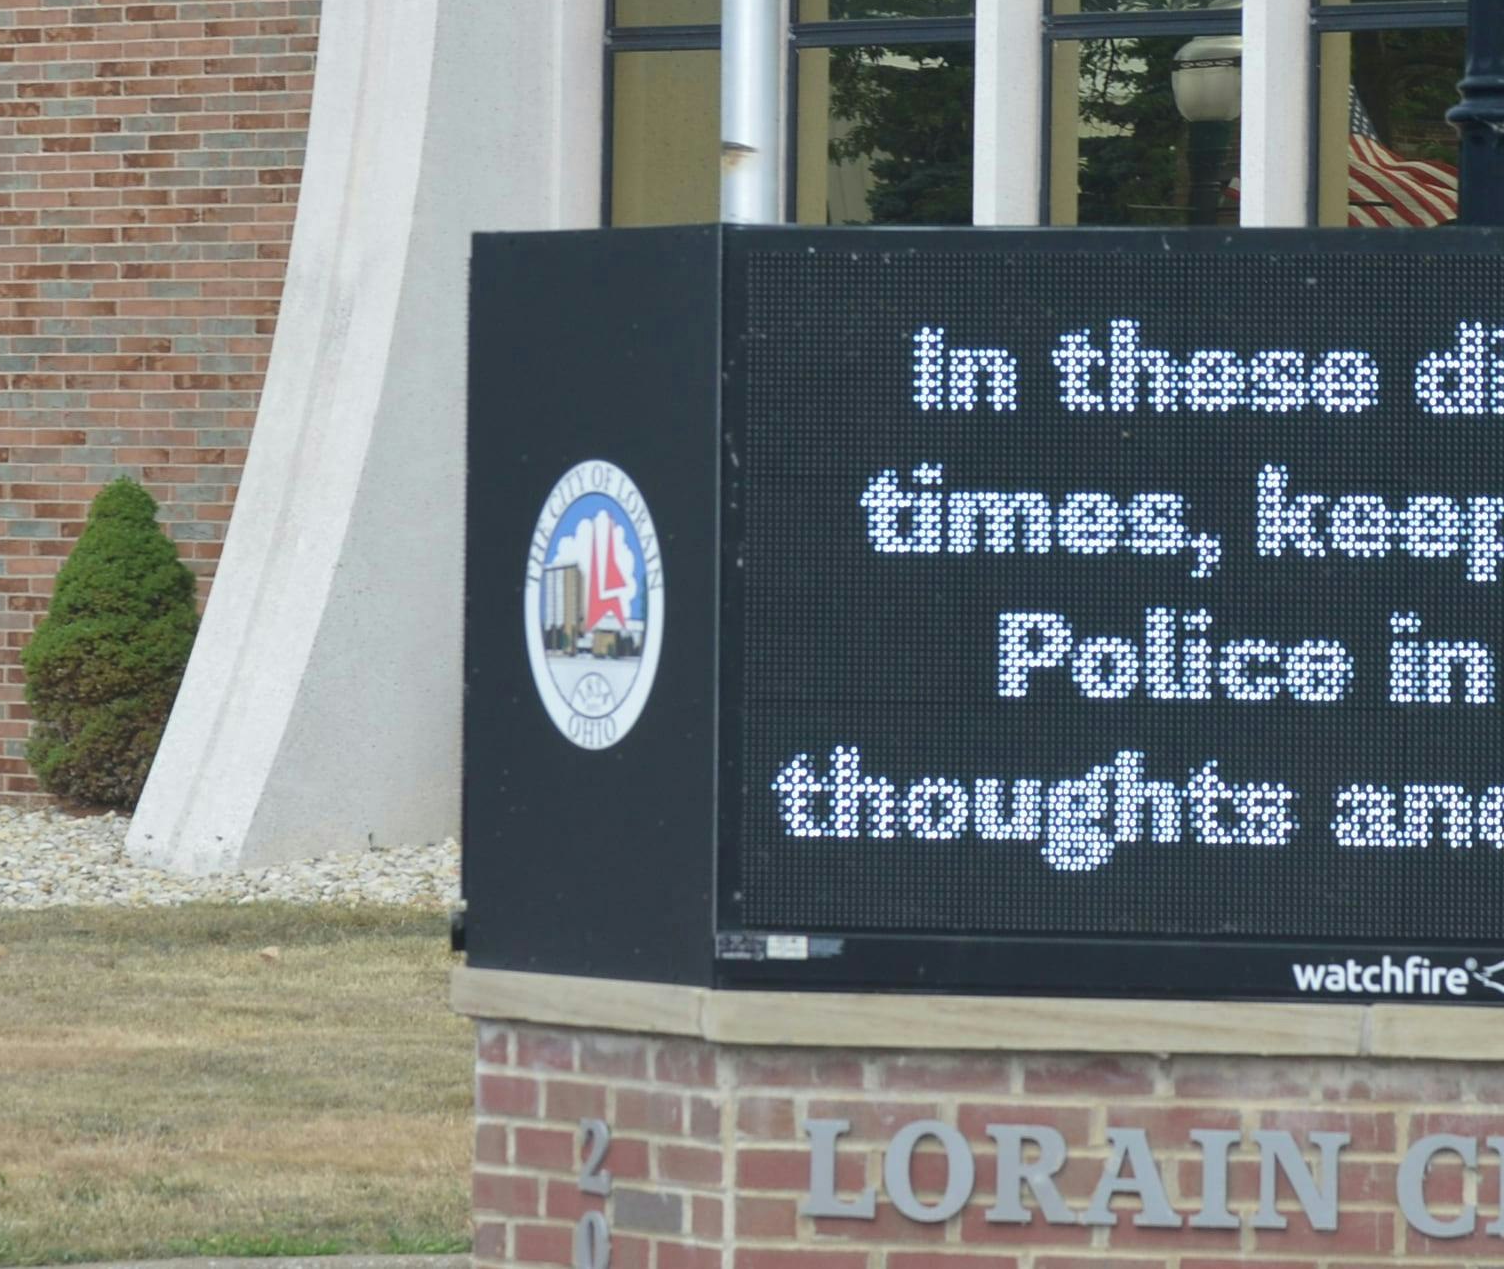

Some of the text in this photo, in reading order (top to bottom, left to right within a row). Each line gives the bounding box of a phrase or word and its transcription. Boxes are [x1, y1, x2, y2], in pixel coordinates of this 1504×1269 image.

[913, 326, 1017, 412] In
[1051, 319, 1380, 413] these
[549, 467, 586, 519] CITY
[591, 464, 614, 491] OF
[616, 475, 662, 590] LORAIN
[860, 462, 1222, 579] times,
[998, 607, 1354, 702] Police
[1389, 611, 1495, 704] in
[568, 715, 617, 746] OHIO
[771, 745, 1300, 872] thoughts
[1293, 956, 1469, 995] watchfire
[799, 1118, 1352, 1232] LORAIN
